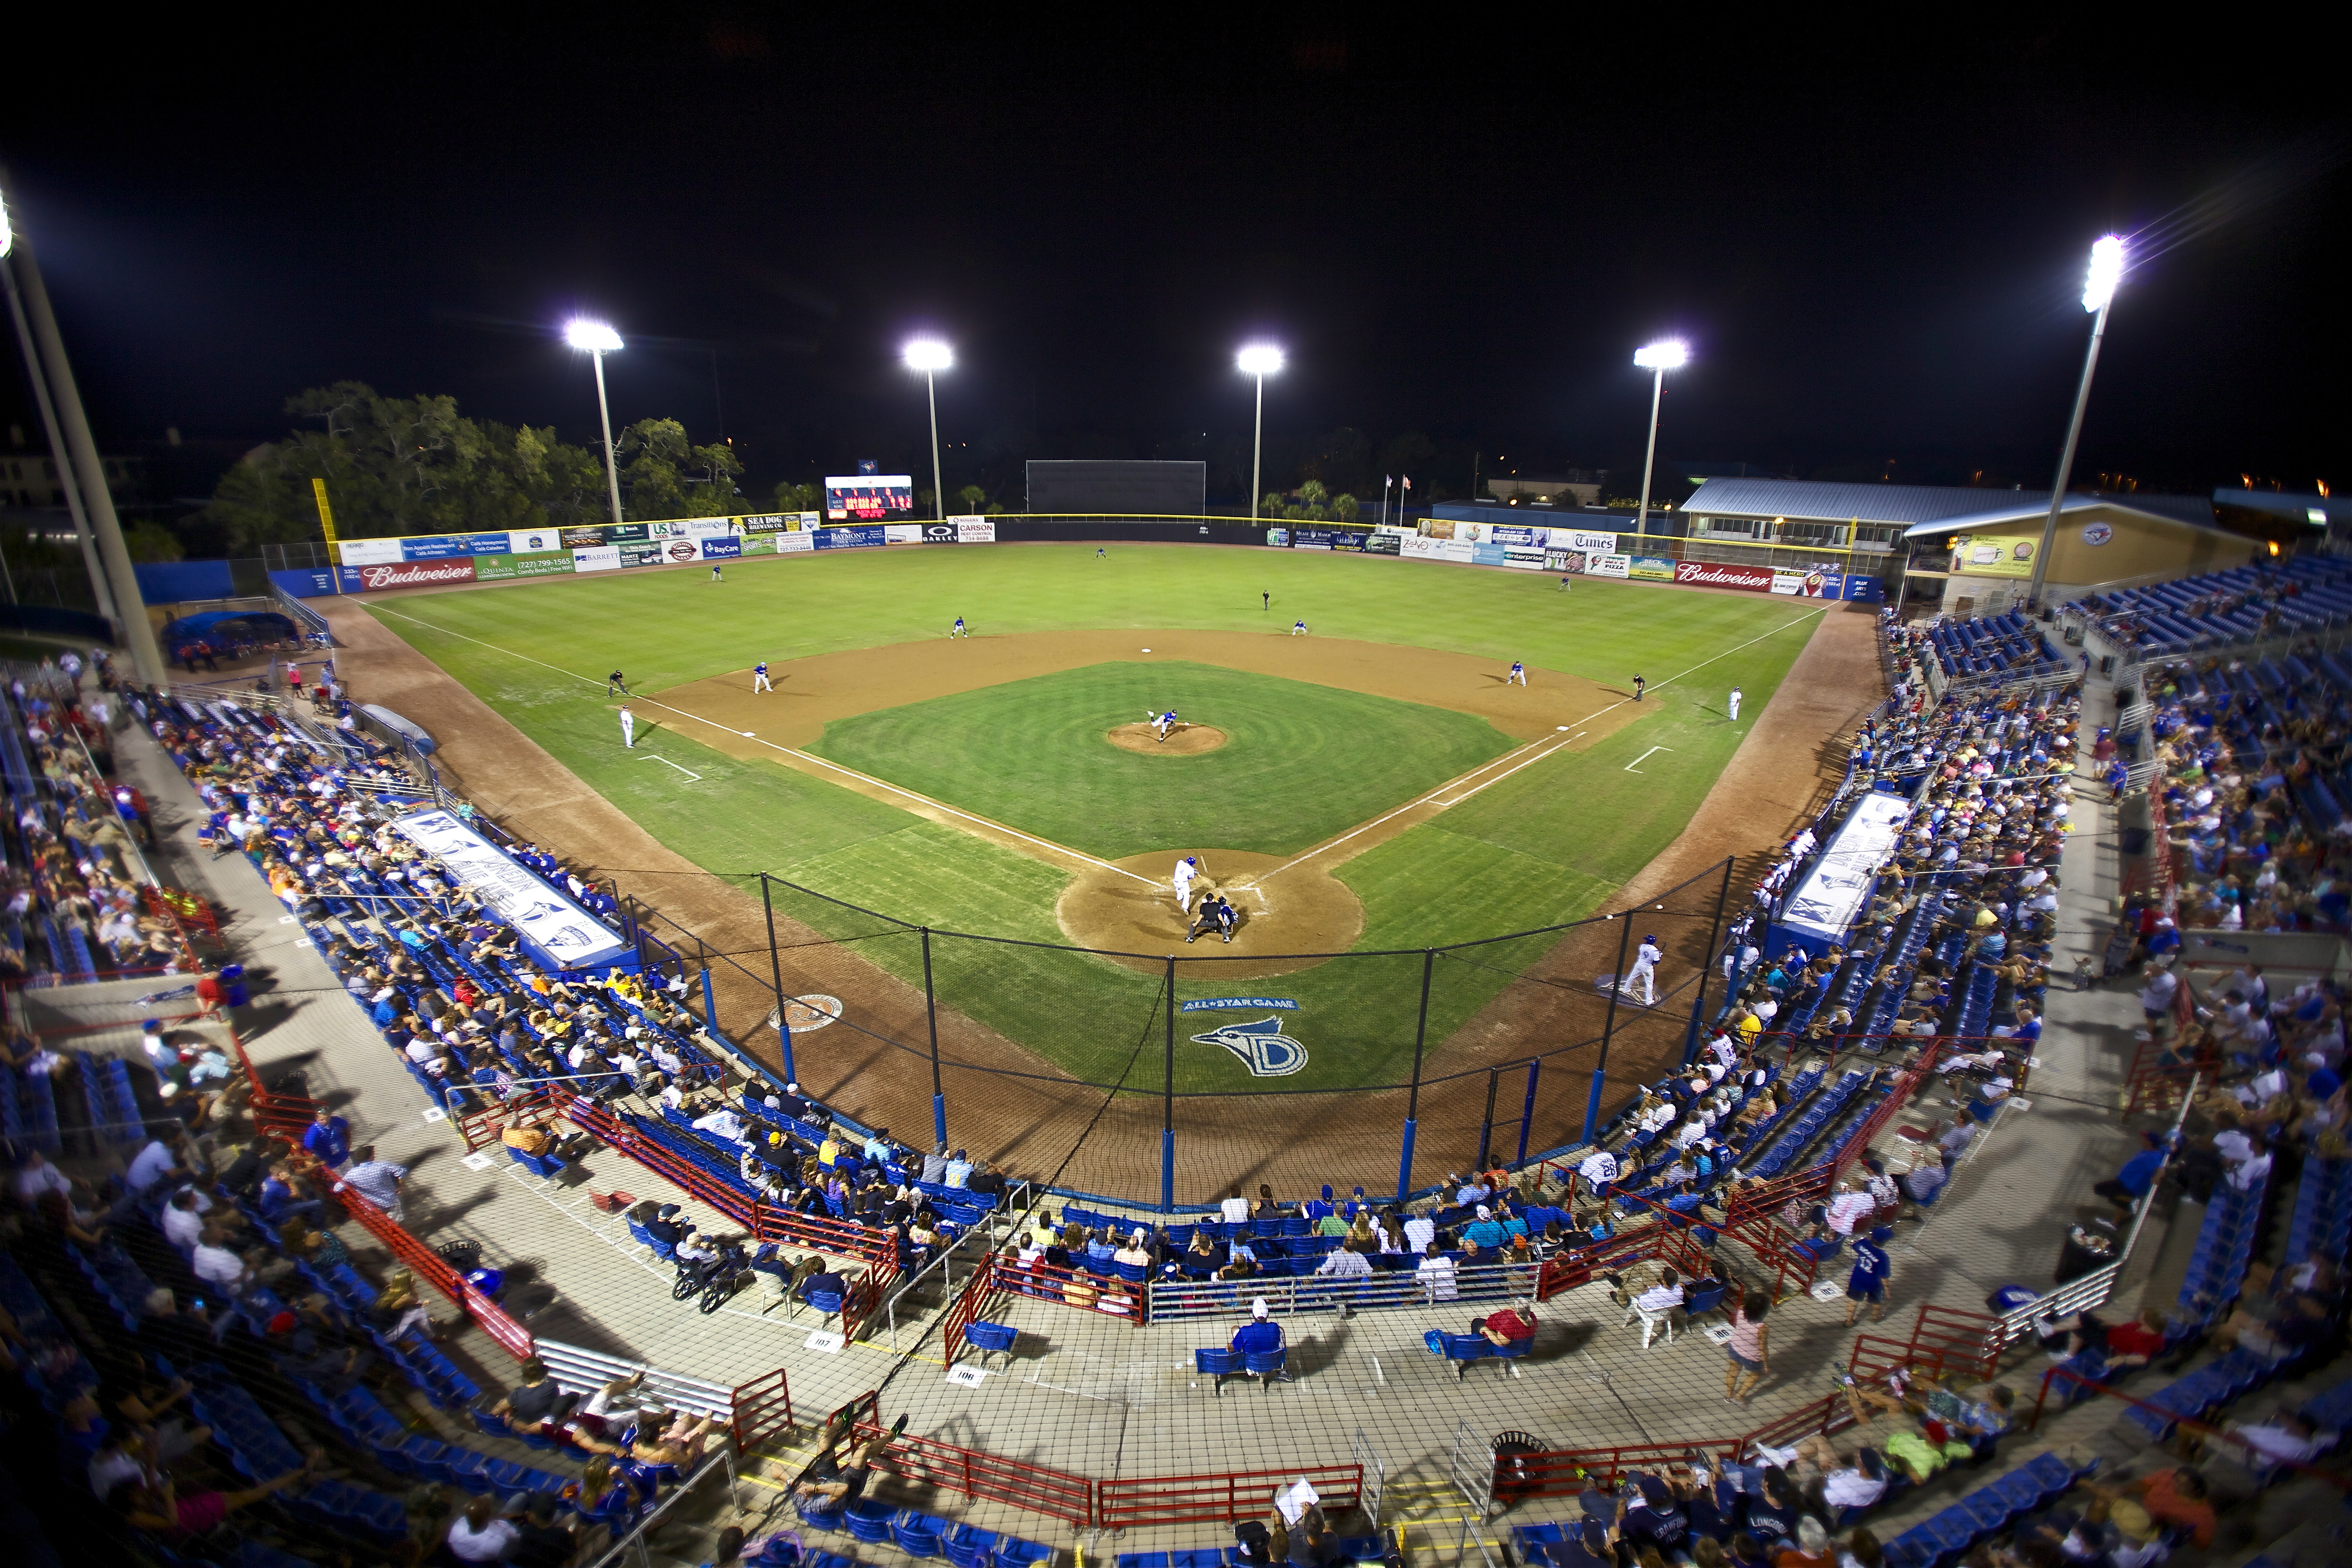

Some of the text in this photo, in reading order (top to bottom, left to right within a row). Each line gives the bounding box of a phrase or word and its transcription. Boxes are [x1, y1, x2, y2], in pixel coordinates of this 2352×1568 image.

[690, 521, 727, 529] Transitions
[743, 542, 761, 552] SPORTS
[1575, 533, 1614, 549] Times
[538, 558, 570, 567] 799-1565
[587, 553, 619, 561] BARRETT
[1507, 552, 1544, 561] enterprise
[363, 564, 472, 587] Budweiser
[1678, 563, 1771, 586] Budweiser
[1825, 832, 1864, 867] DUNEDIN
[449, 861, 489, 882] BLUE
[477, 854, 540, 892] DUNEDIN
[1253, 998, 1295, 1008] GAME
[1603, 1163, 1616, 1178] 28
[815, 1338, 831, 1347] 107
[1654, 1516, 1688, 1539] CRAWFOR
